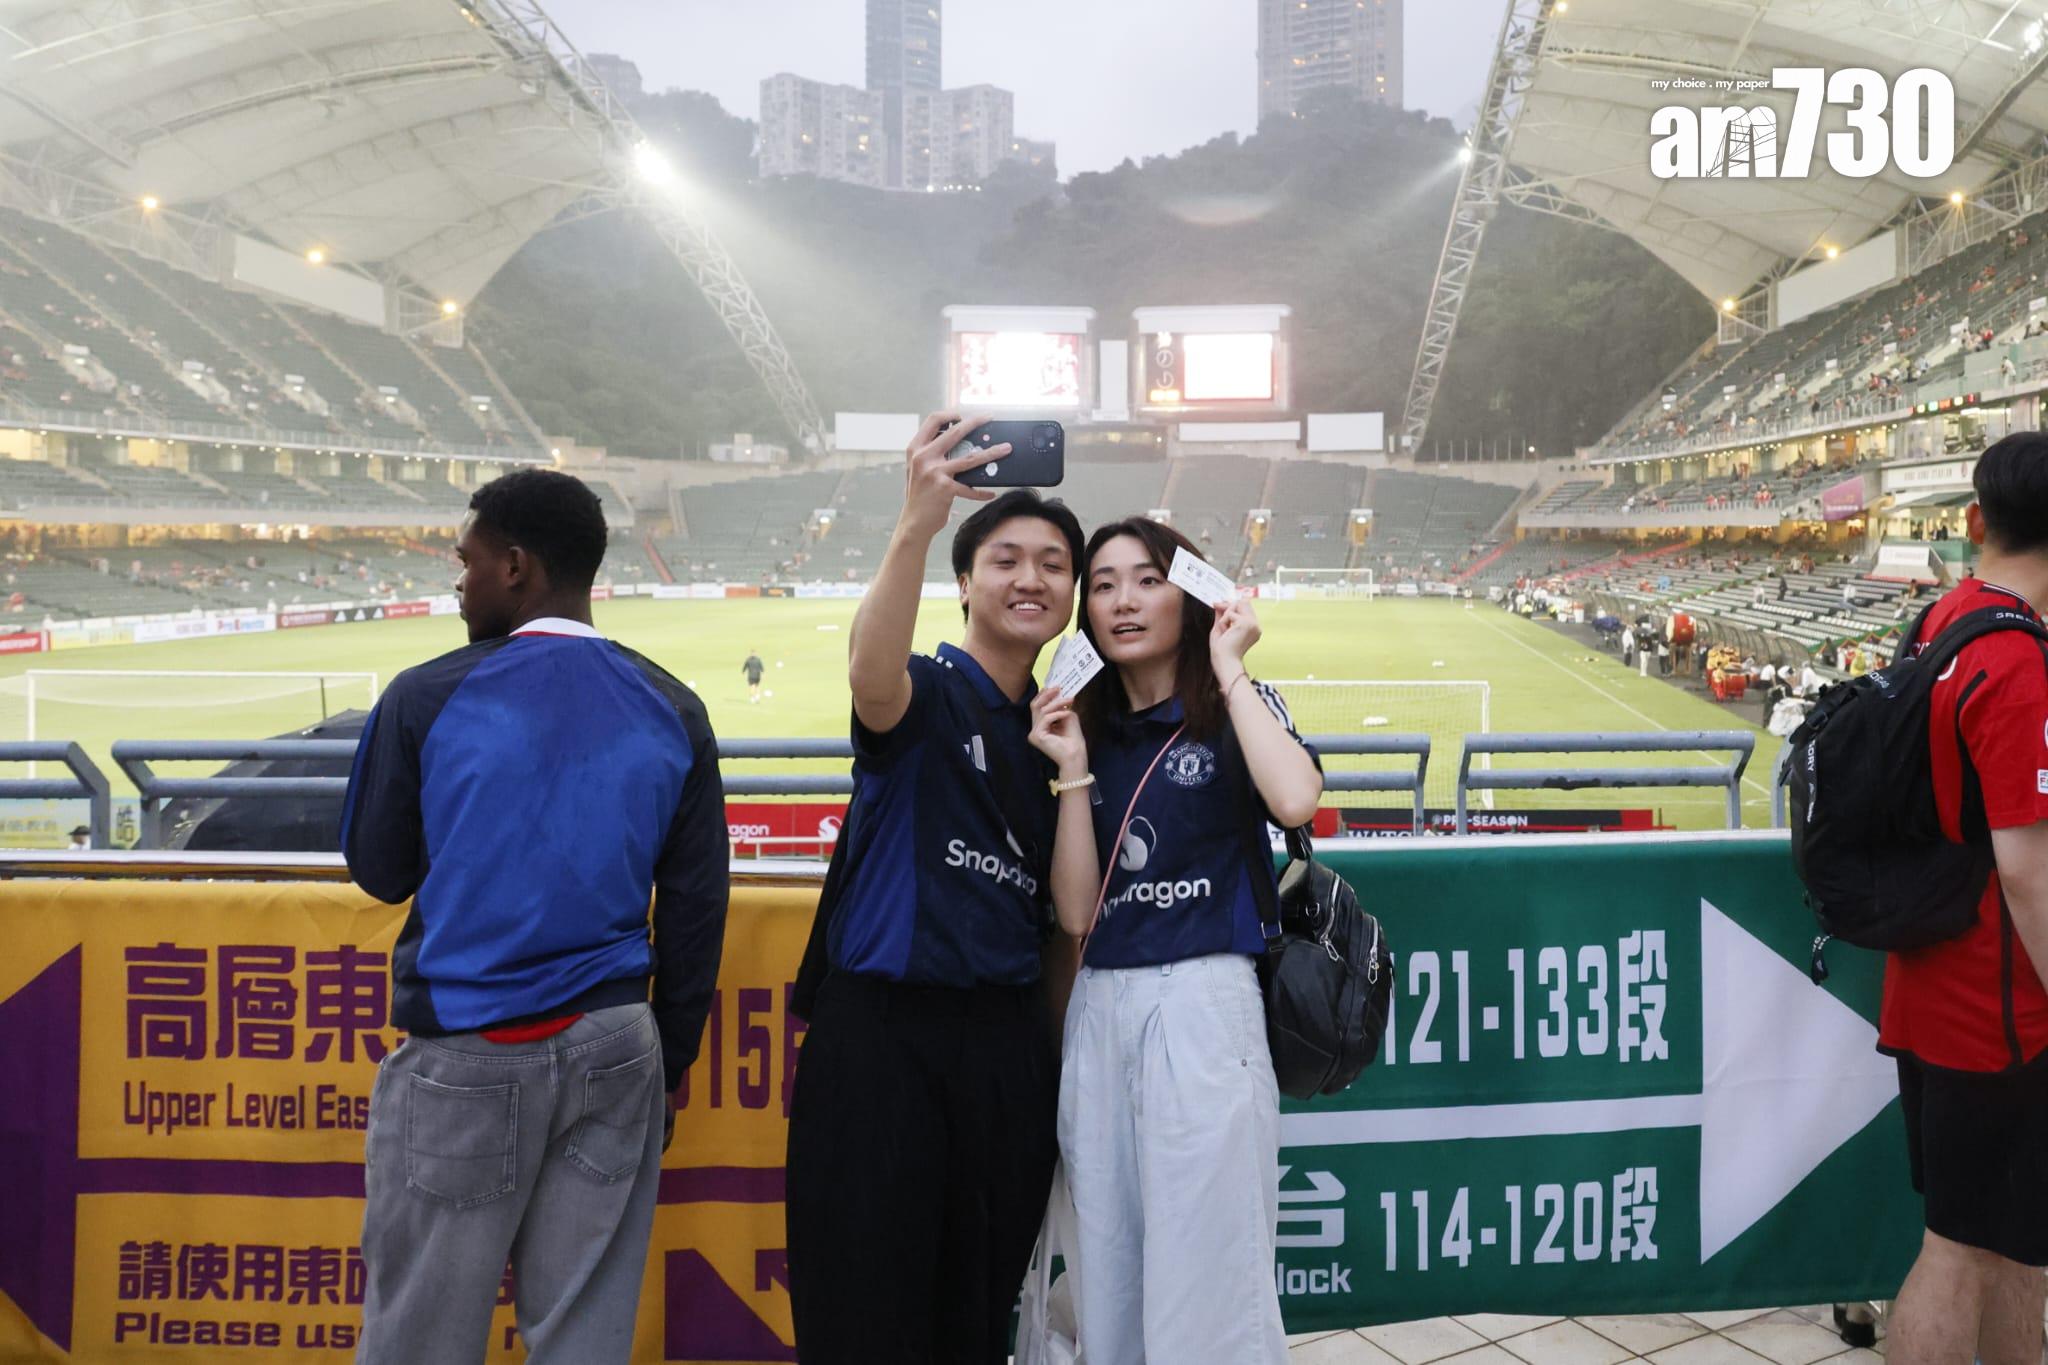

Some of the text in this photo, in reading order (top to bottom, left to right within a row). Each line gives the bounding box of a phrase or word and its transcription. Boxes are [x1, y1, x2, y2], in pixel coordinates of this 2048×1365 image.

[1443, 814, 1528, 827] PR-SEASON
[124, 942, 408, 1062] 高層東
[124, 1081, 217, 1136] Upper
[226, 1082, 305, 1130] Level
[1380, 1167, 1658, 1271] 114-120段
[114, 1312, 362, 1349] Please us
